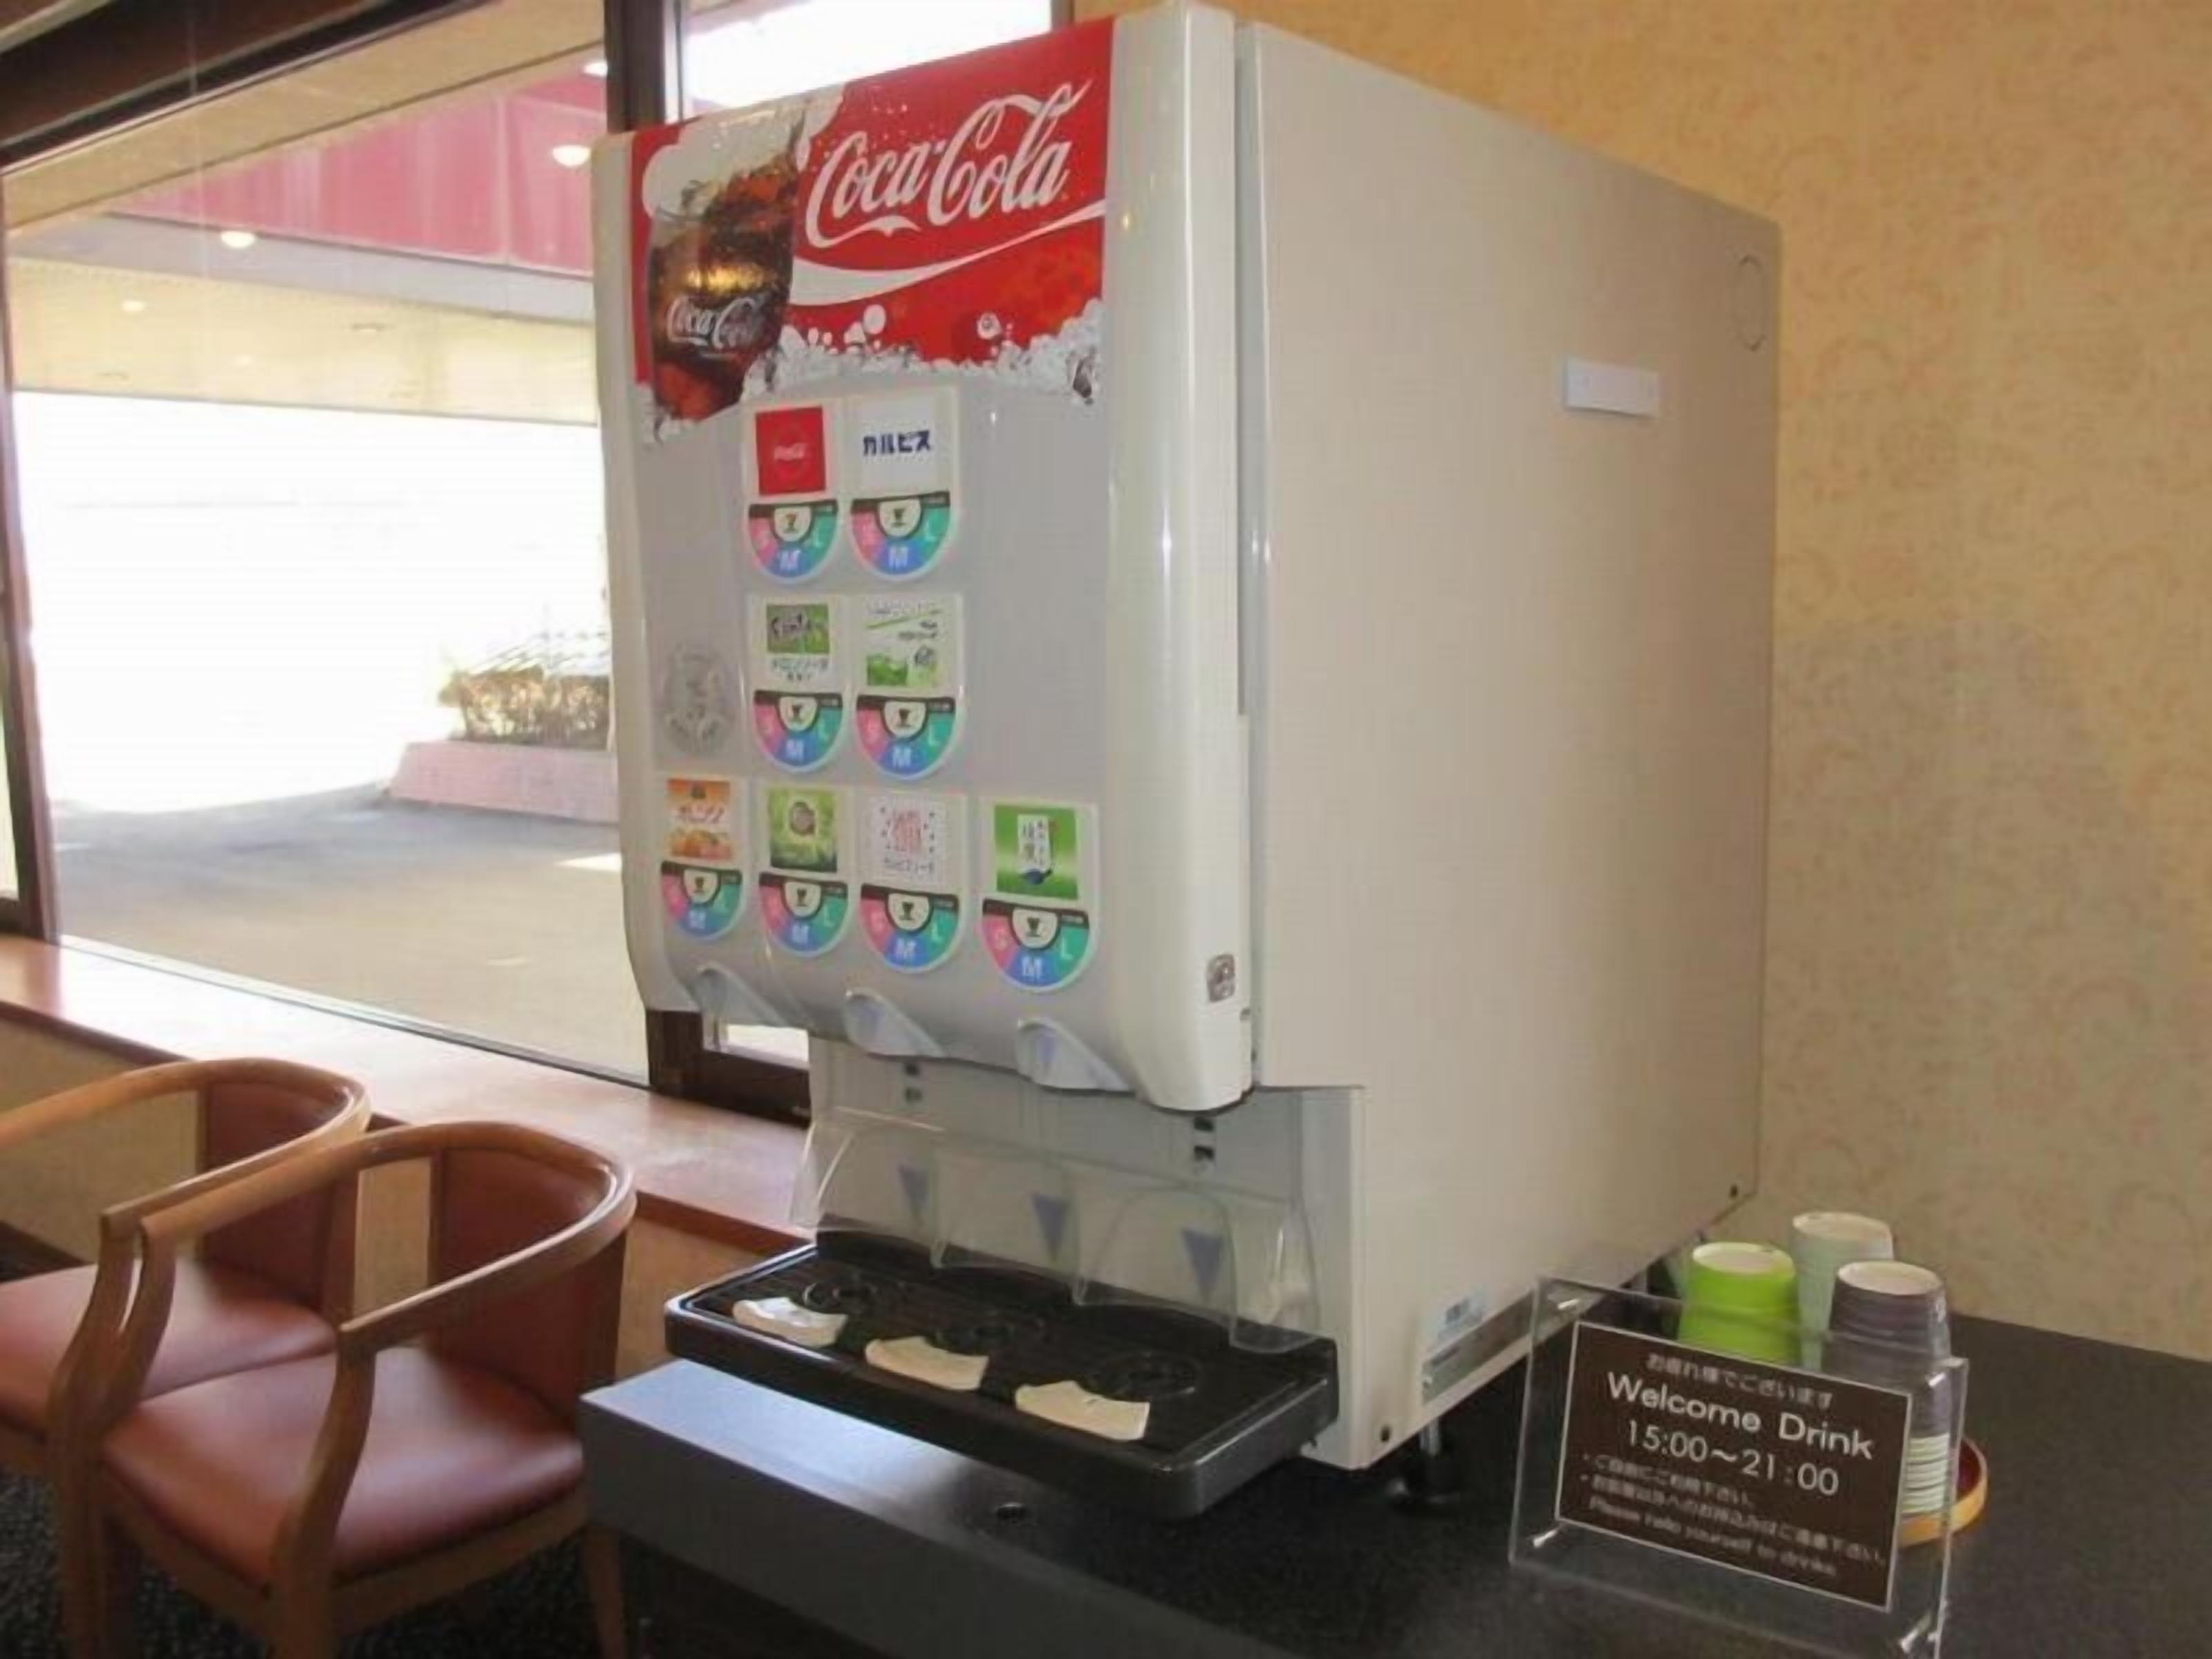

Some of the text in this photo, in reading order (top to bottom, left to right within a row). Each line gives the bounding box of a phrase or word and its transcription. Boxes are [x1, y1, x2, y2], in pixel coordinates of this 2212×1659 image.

[805, 79, 1092, 248] Coca-Cola
[667, 293, 769, 350] CocaC
[1061, 938, 1074, 960] L
[1608, 1371, 1874, 1459] Welcome Drink
